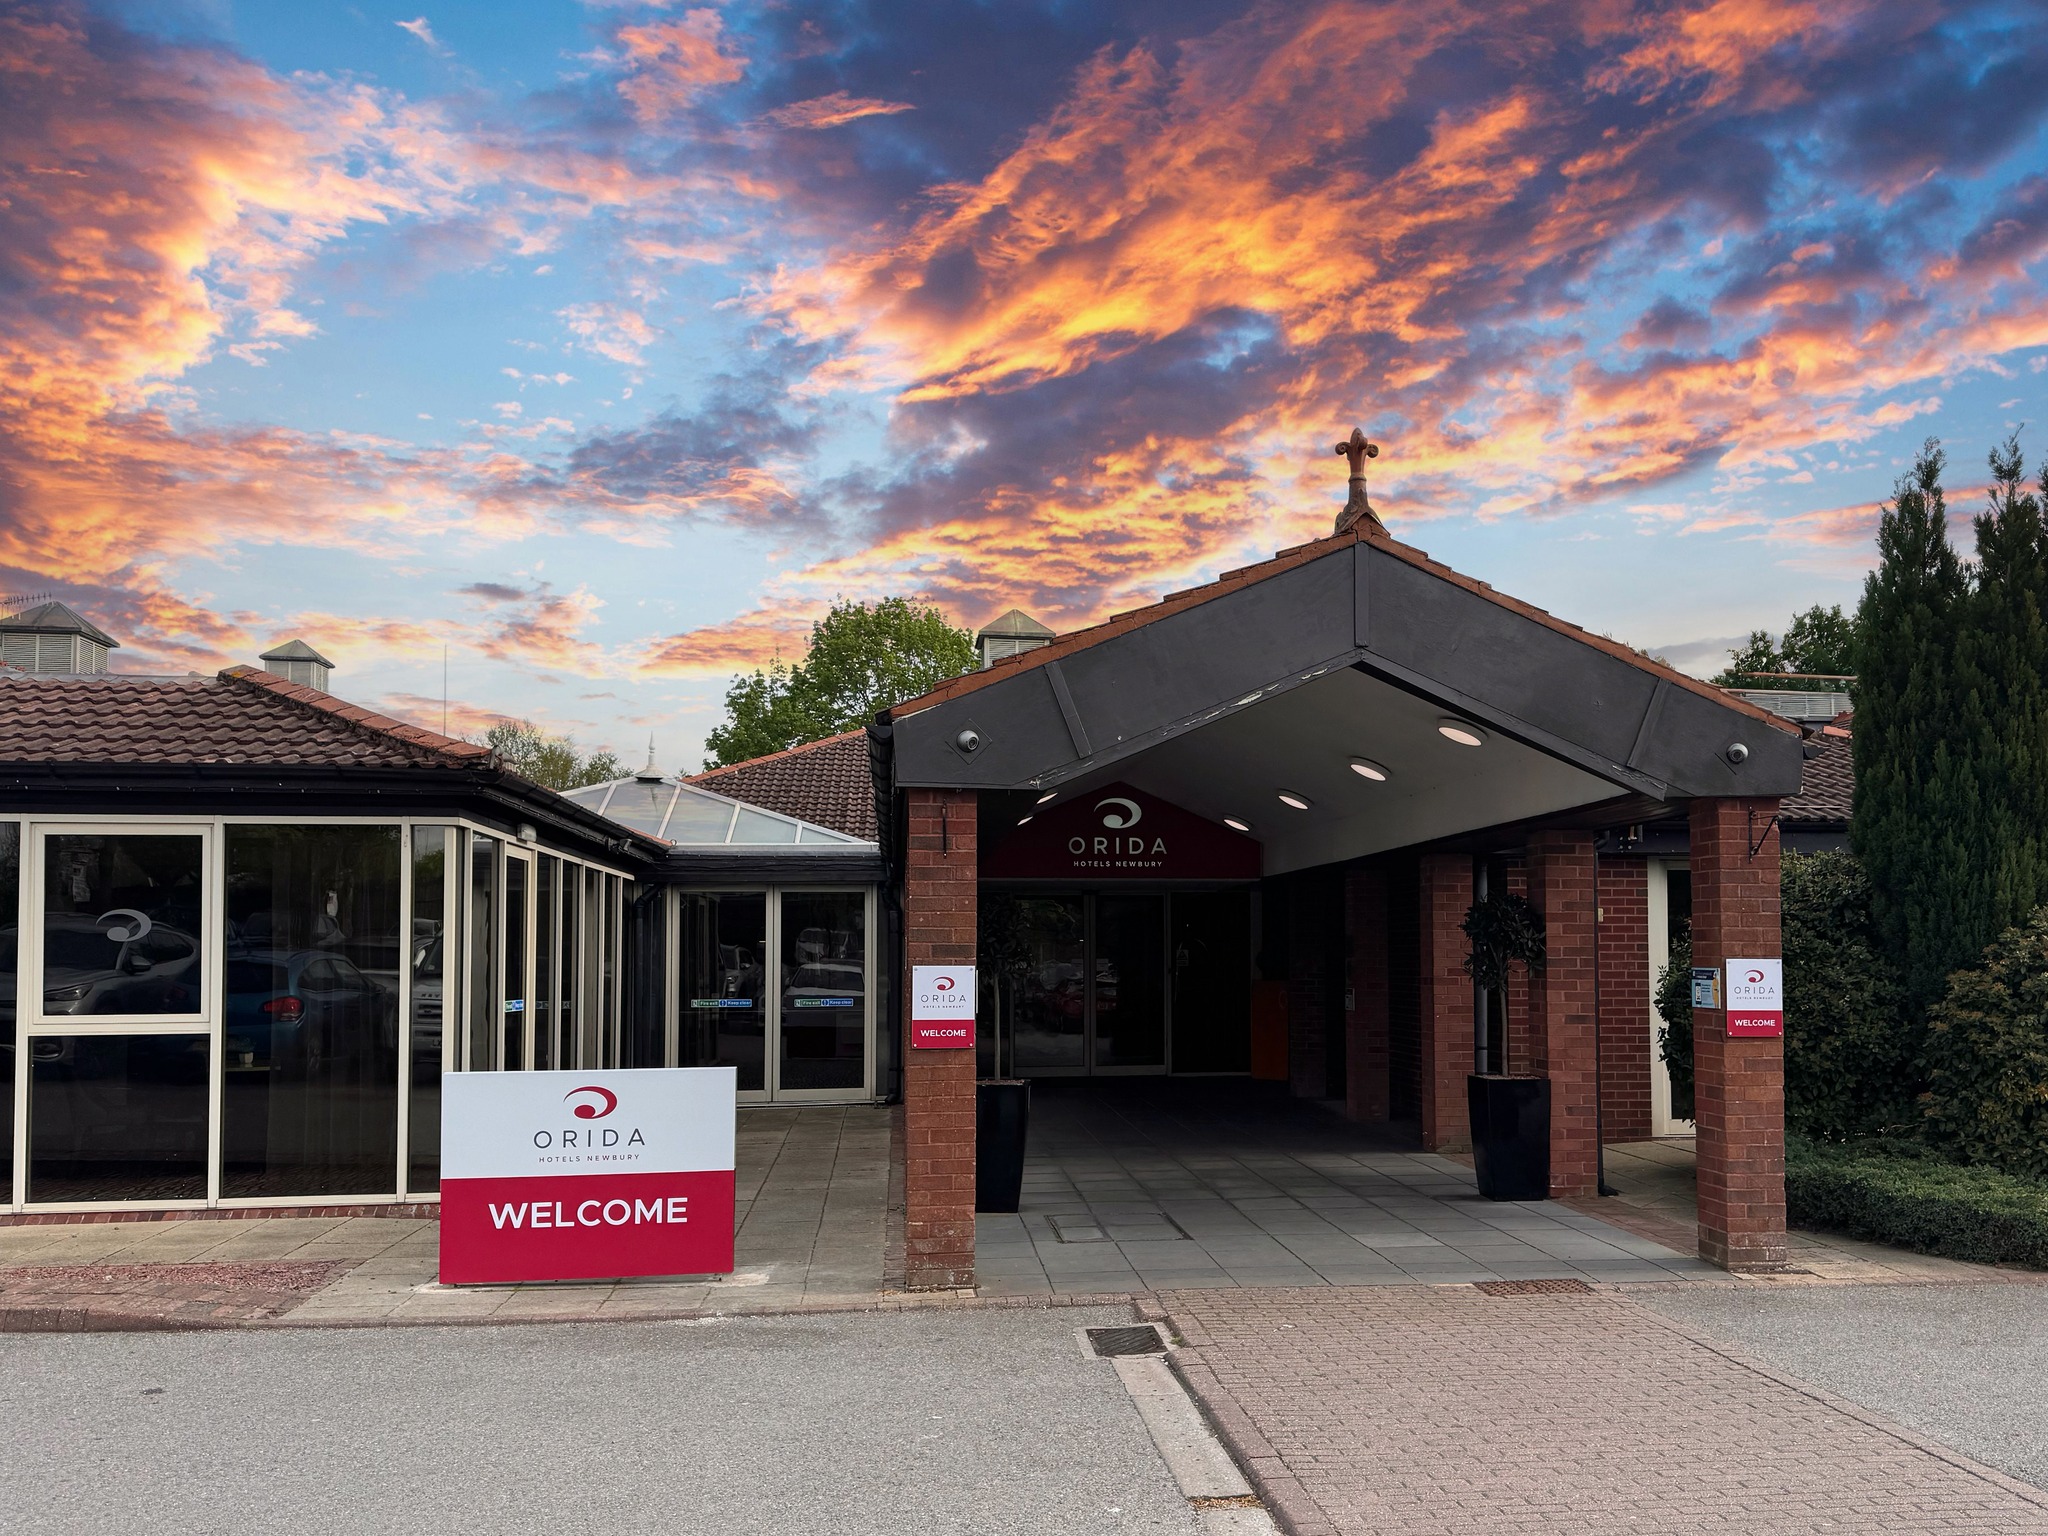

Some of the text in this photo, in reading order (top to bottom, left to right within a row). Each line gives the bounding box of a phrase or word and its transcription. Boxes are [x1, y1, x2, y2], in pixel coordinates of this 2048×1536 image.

[1068, 836, 1168, 855] ORIDA
[1073, 860, 1163, 868] HOTELS NEWBURY
[1734, 986, 1775, 994] ORIDA
[920, 994, 967, 1003] ORIDA
[1734, 1019, 1776, 1027] WELCOME
[920, 1029, 967, 1037] WELCOME
[533, 1128, 645, 1149] ORIDA
[586, 1154, 640, 1162] NEWBURY
[488, 1197, 688, 1230] WELCOME
